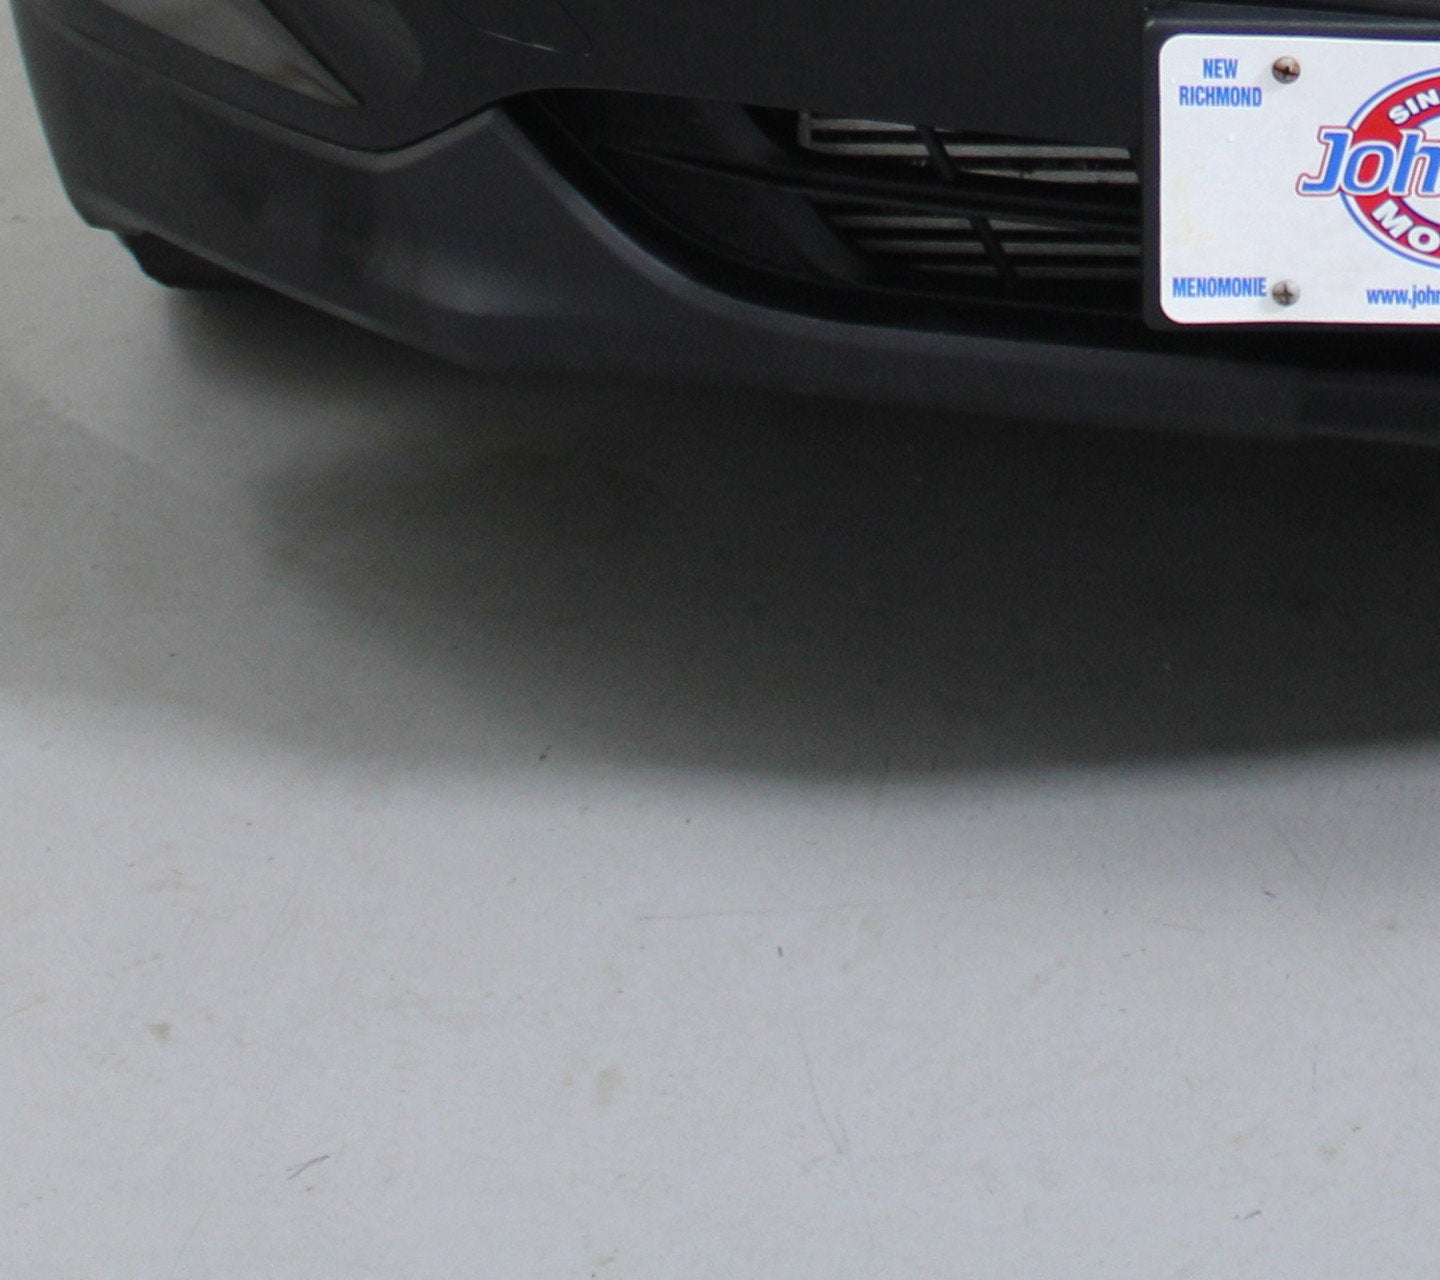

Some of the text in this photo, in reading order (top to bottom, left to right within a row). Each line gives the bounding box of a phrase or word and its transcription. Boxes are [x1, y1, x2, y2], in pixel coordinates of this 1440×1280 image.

[1203, 59, 1238, 80] NEW
[1179, 85, 1262, 107] RICHMOND
[1173, 276, 1267, 298] MENOMONIE
